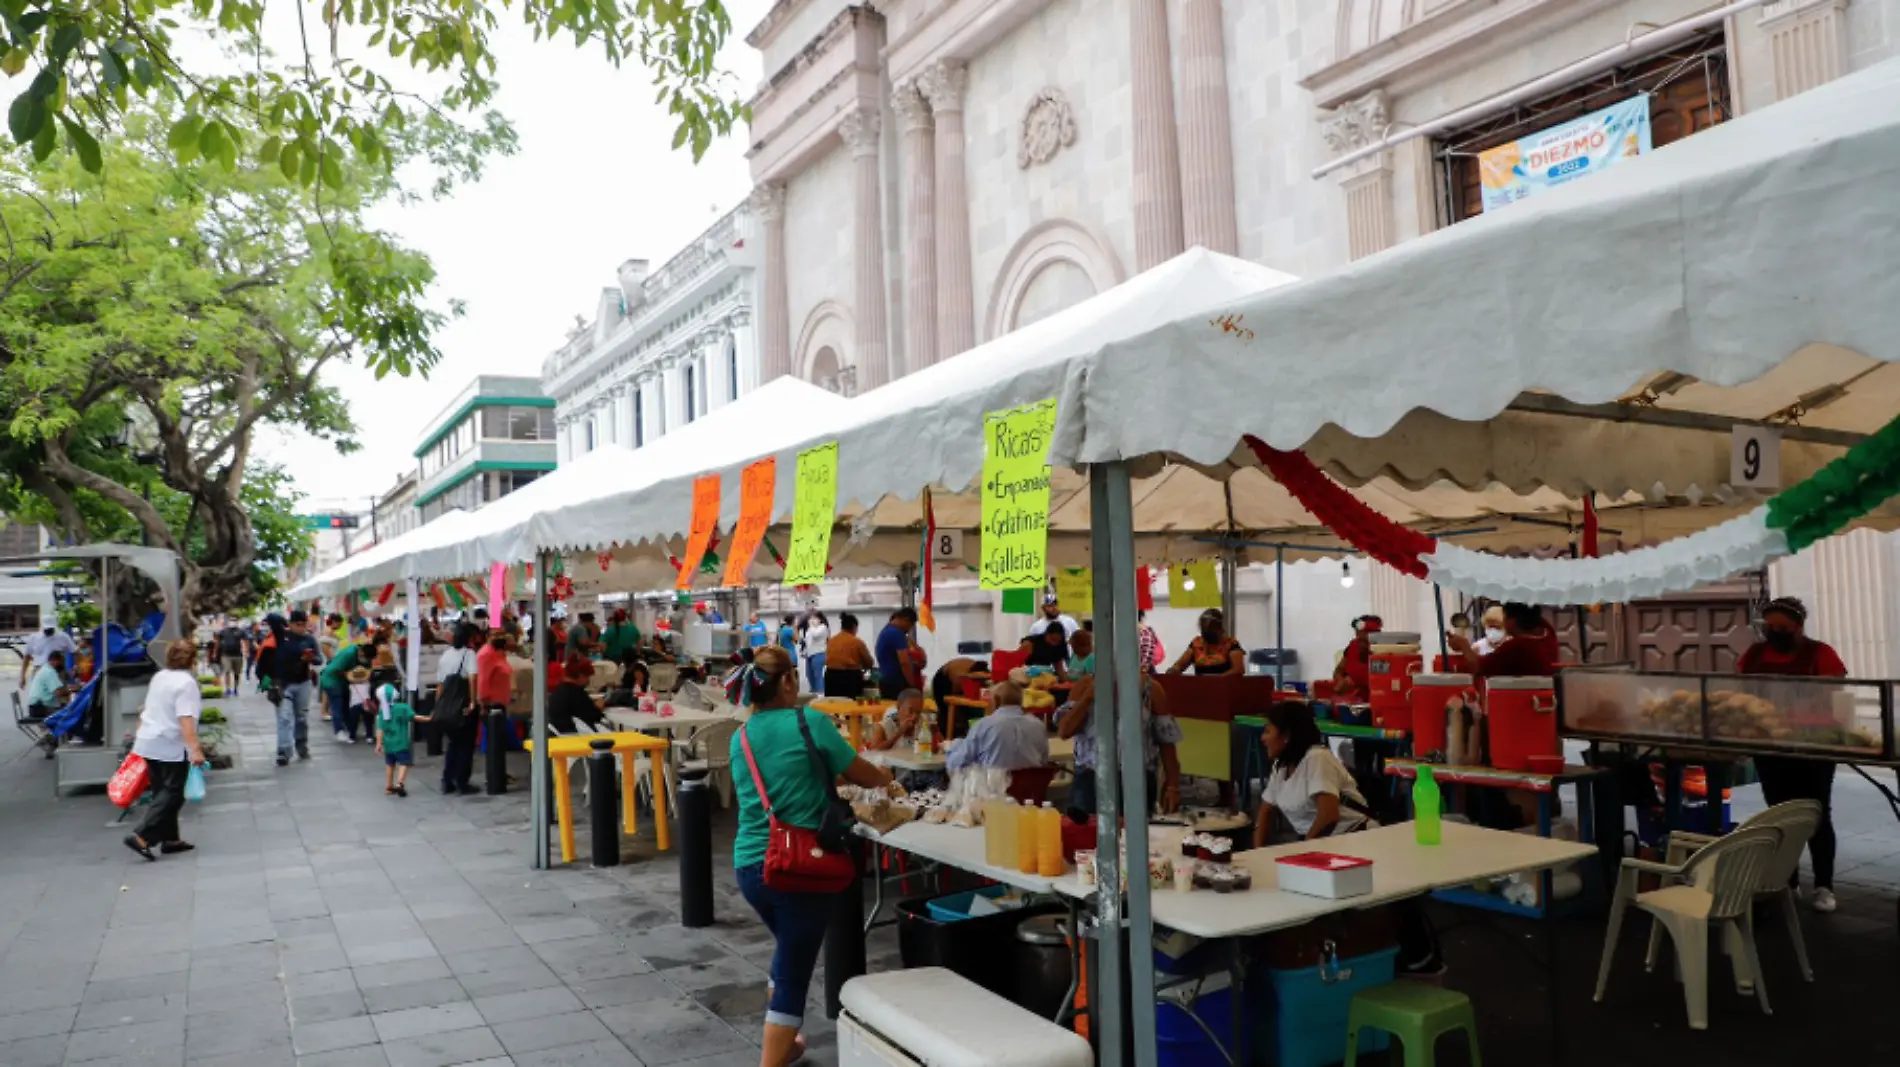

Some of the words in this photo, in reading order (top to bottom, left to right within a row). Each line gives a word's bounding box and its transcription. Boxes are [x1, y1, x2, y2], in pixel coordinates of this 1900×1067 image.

[1529, 131, 1605, 169] DIEZMO
[995, 421, 1043, 459] Ricas
[1743, 437, 1761, 481] 9
[991, 508, 1045, 540] Gelatinas
[941, 534, 953, 555] 8
[990, 544, 1041, 578] Galletas
